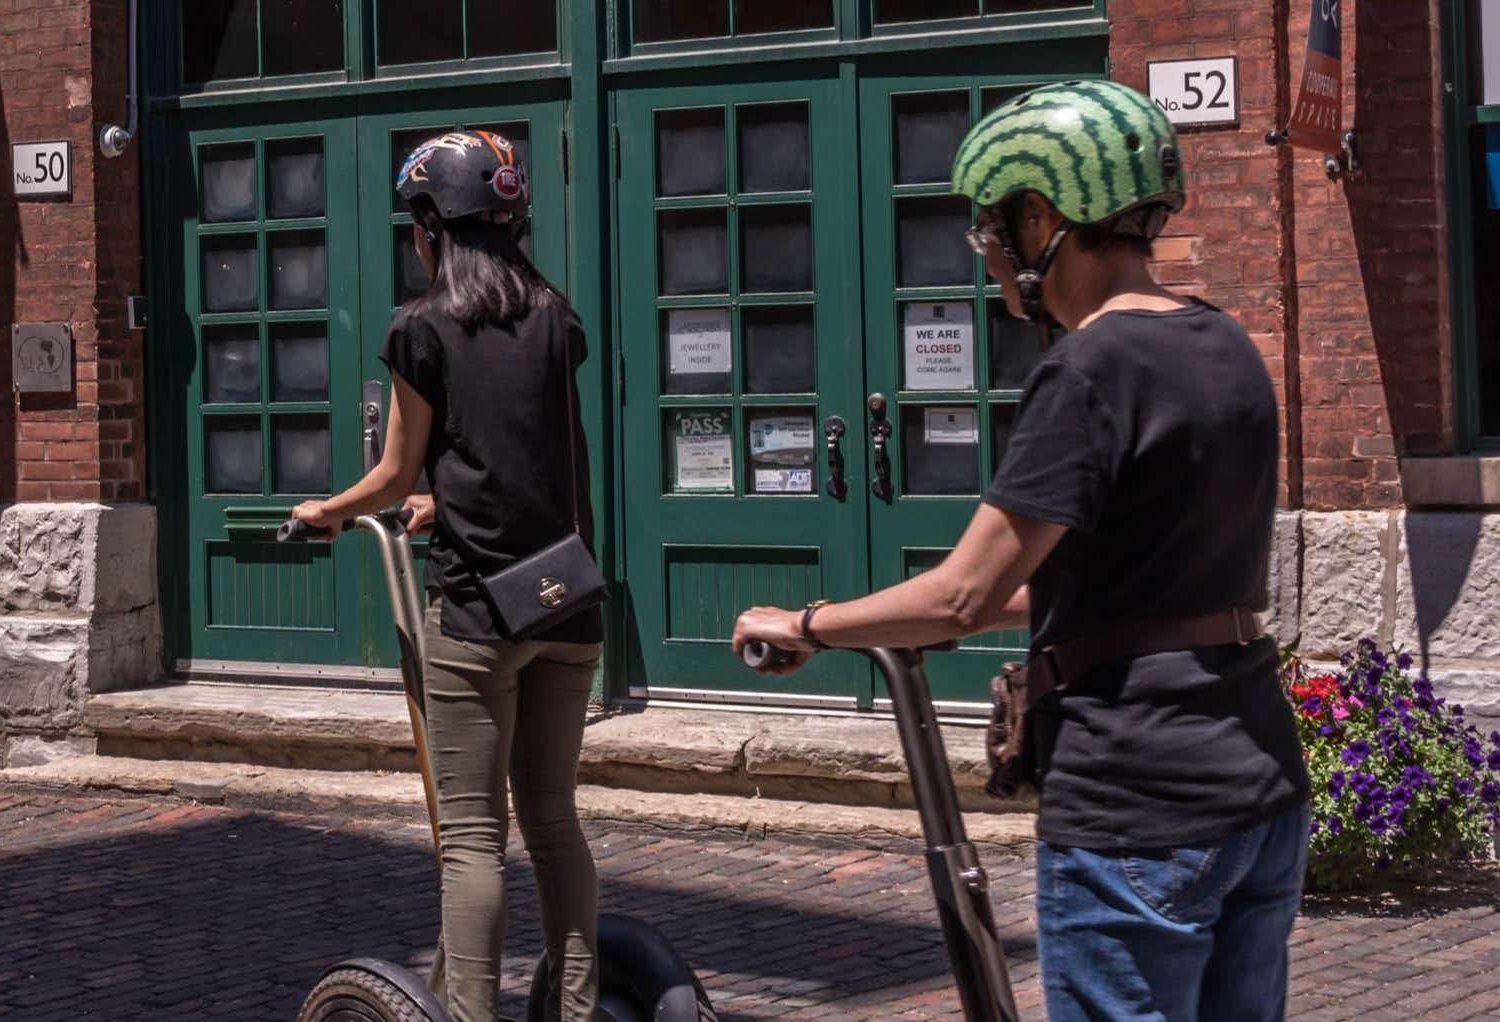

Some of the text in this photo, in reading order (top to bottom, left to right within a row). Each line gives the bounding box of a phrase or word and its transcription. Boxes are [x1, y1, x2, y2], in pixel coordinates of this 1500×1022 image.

[1182, 70, 1230, 110] 52
[34, 151, 65, 183] 50
[916, 329, 961, 340] WE ARE
[915, 343, 962, 354] CLOSED
[680, 417, 724, 435] PASS
